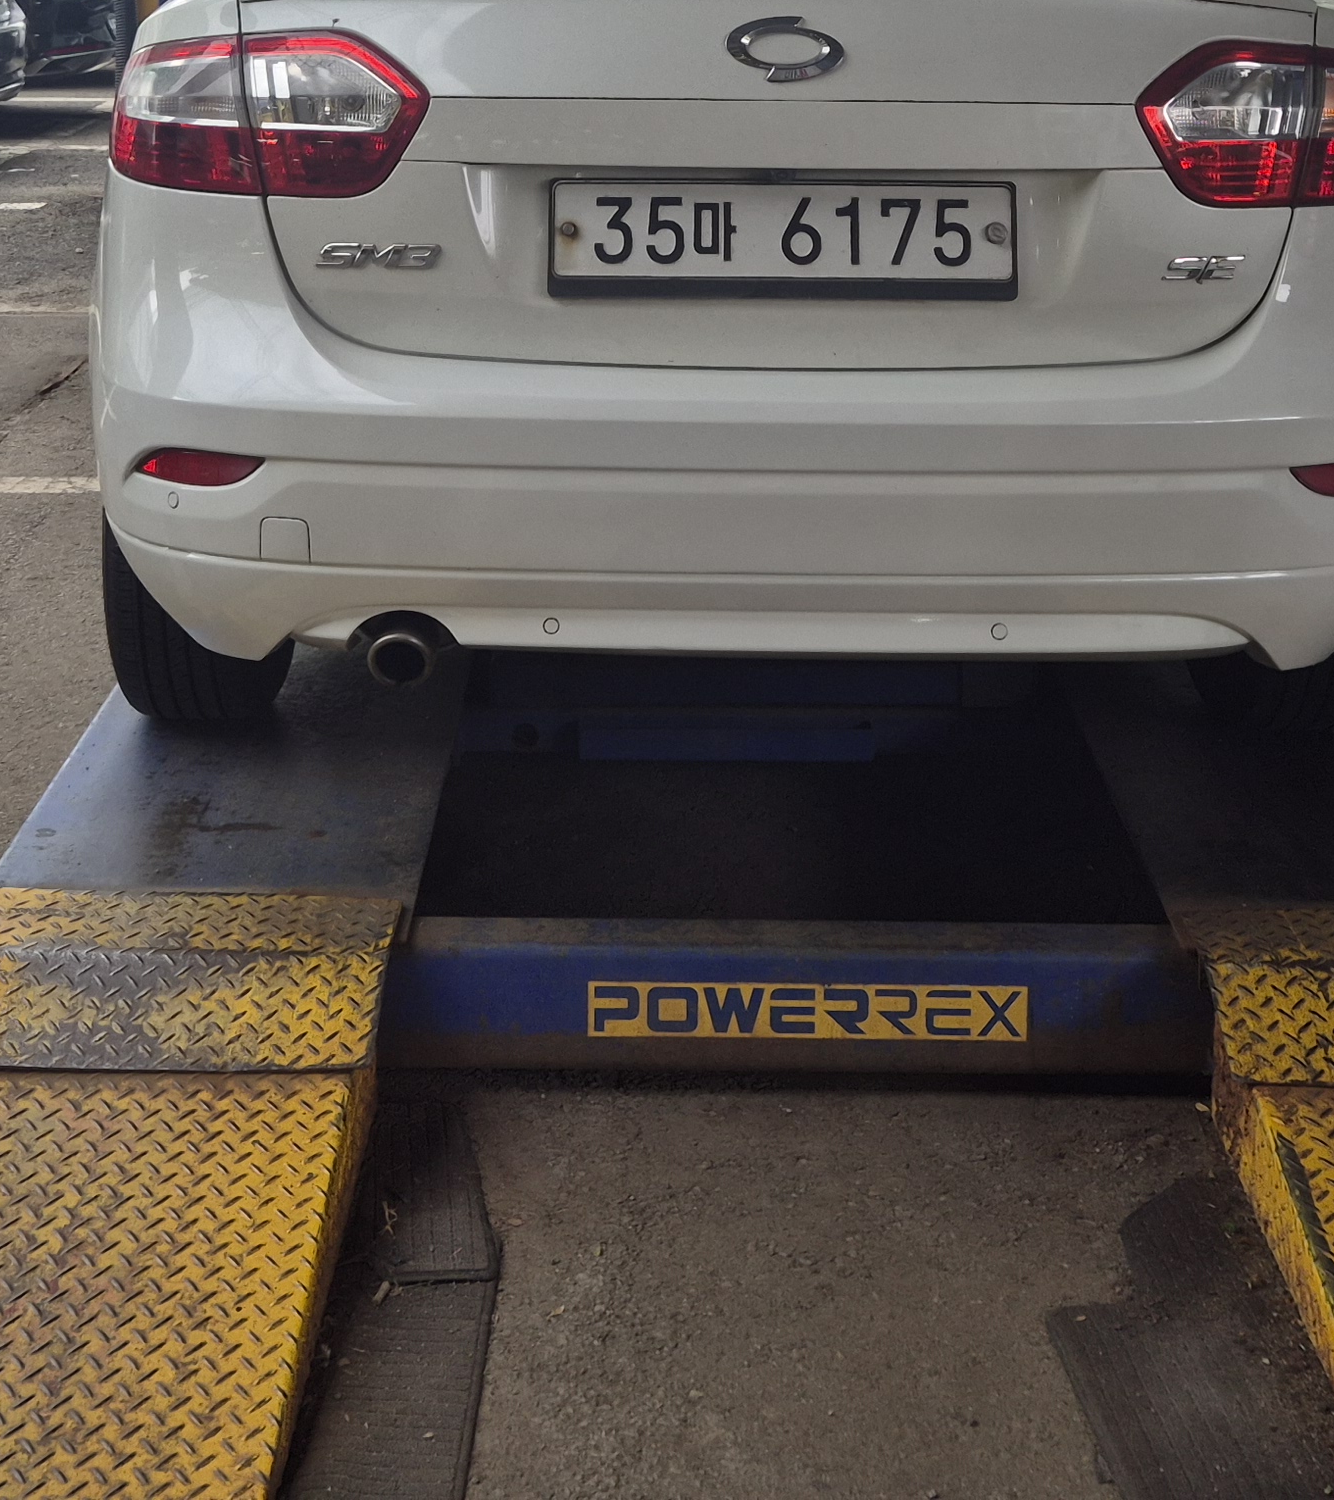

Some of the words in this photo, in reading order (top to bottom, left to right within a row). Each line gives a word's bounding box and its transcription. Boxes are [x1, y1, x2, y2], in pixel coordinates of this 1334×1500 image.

[315, 242, 442, 270] SM3
[594, 197, 737, 264] 35마
[781, 197, 972, 266] 6175
[593, 986, 1023, 1037] POWERREX
